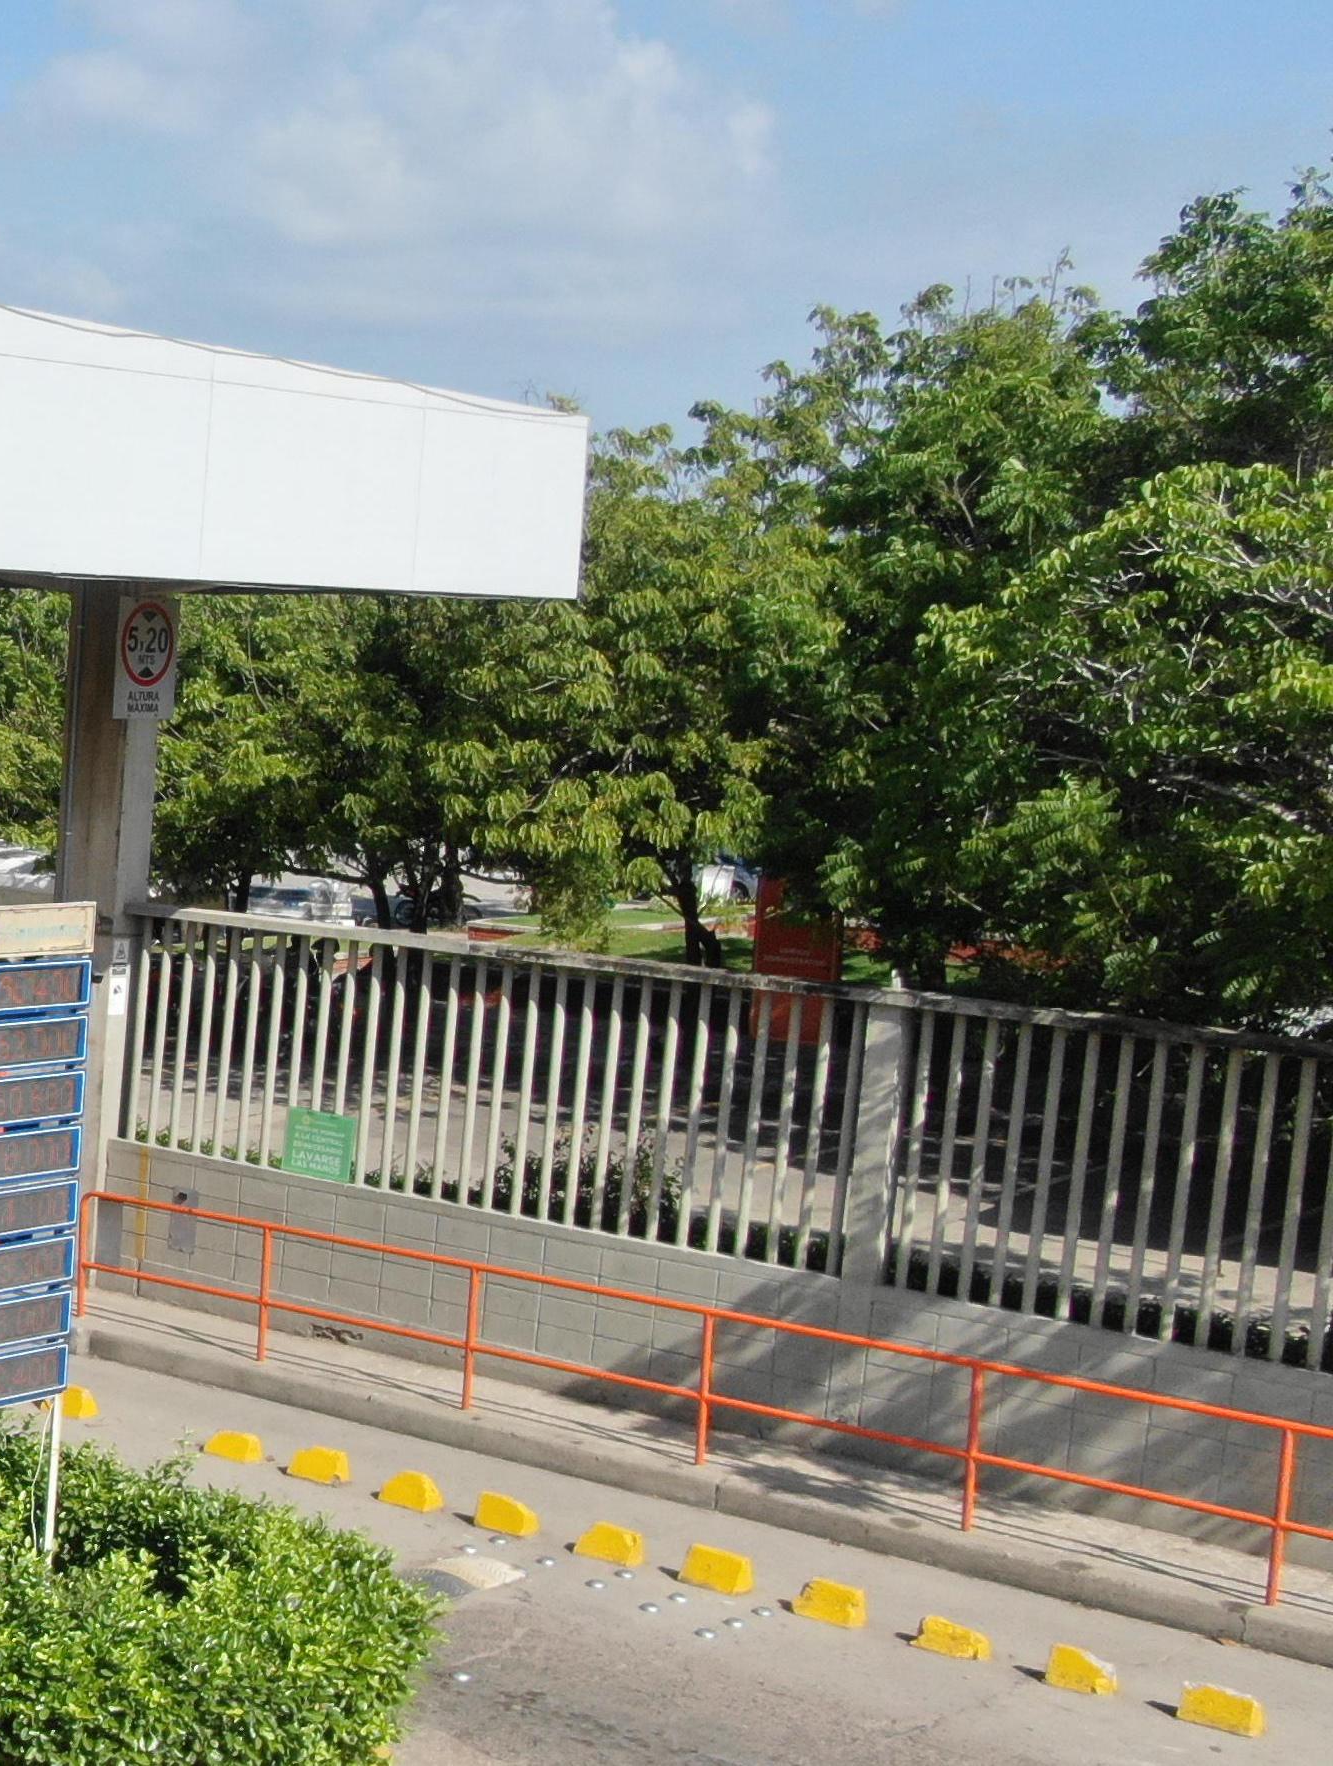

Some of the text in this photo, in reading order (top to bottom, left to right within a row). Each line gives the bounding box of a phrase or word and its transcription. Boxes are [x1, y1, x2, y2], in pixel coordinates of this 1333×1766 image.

[127, 627, 169, 653] 5,20
[138, 654, 155, 665] MTS
[127, 691, 160, 702] ALTURA
[291, 1149, 341, 1168] LAVARSE
